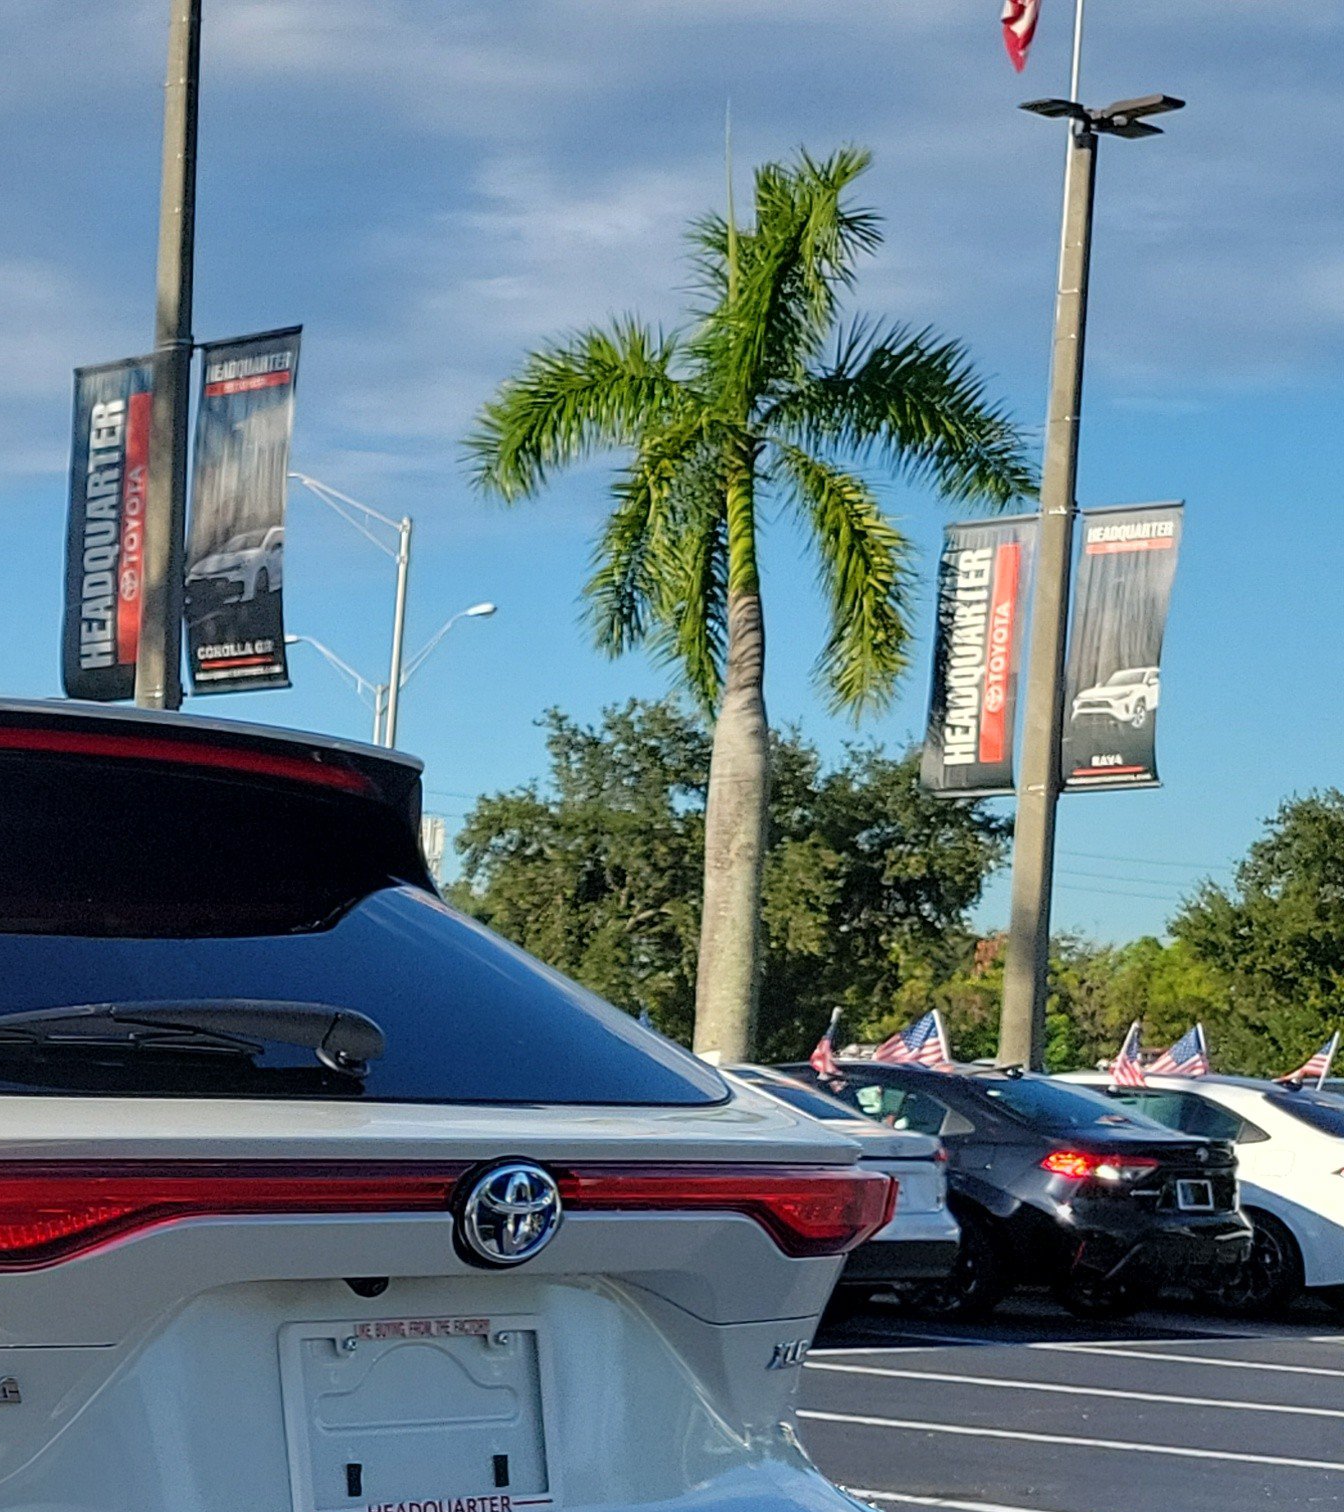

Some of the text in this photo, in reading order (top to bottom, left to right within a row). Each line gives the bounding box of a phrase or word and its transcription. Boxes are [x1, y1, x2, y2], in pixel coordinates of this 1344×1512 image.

[79, 399, 126, 670] HEADQUARTER
[122, 465, 145, 565] TOYOTA
[1087, 521, 1174, 543] HEADQUARTER
[197, 641, 253, 660] COROLLA
[943, 546, 993, 765] HEADQUARTER
[988, 599, 1011, 683] TOYOTA
